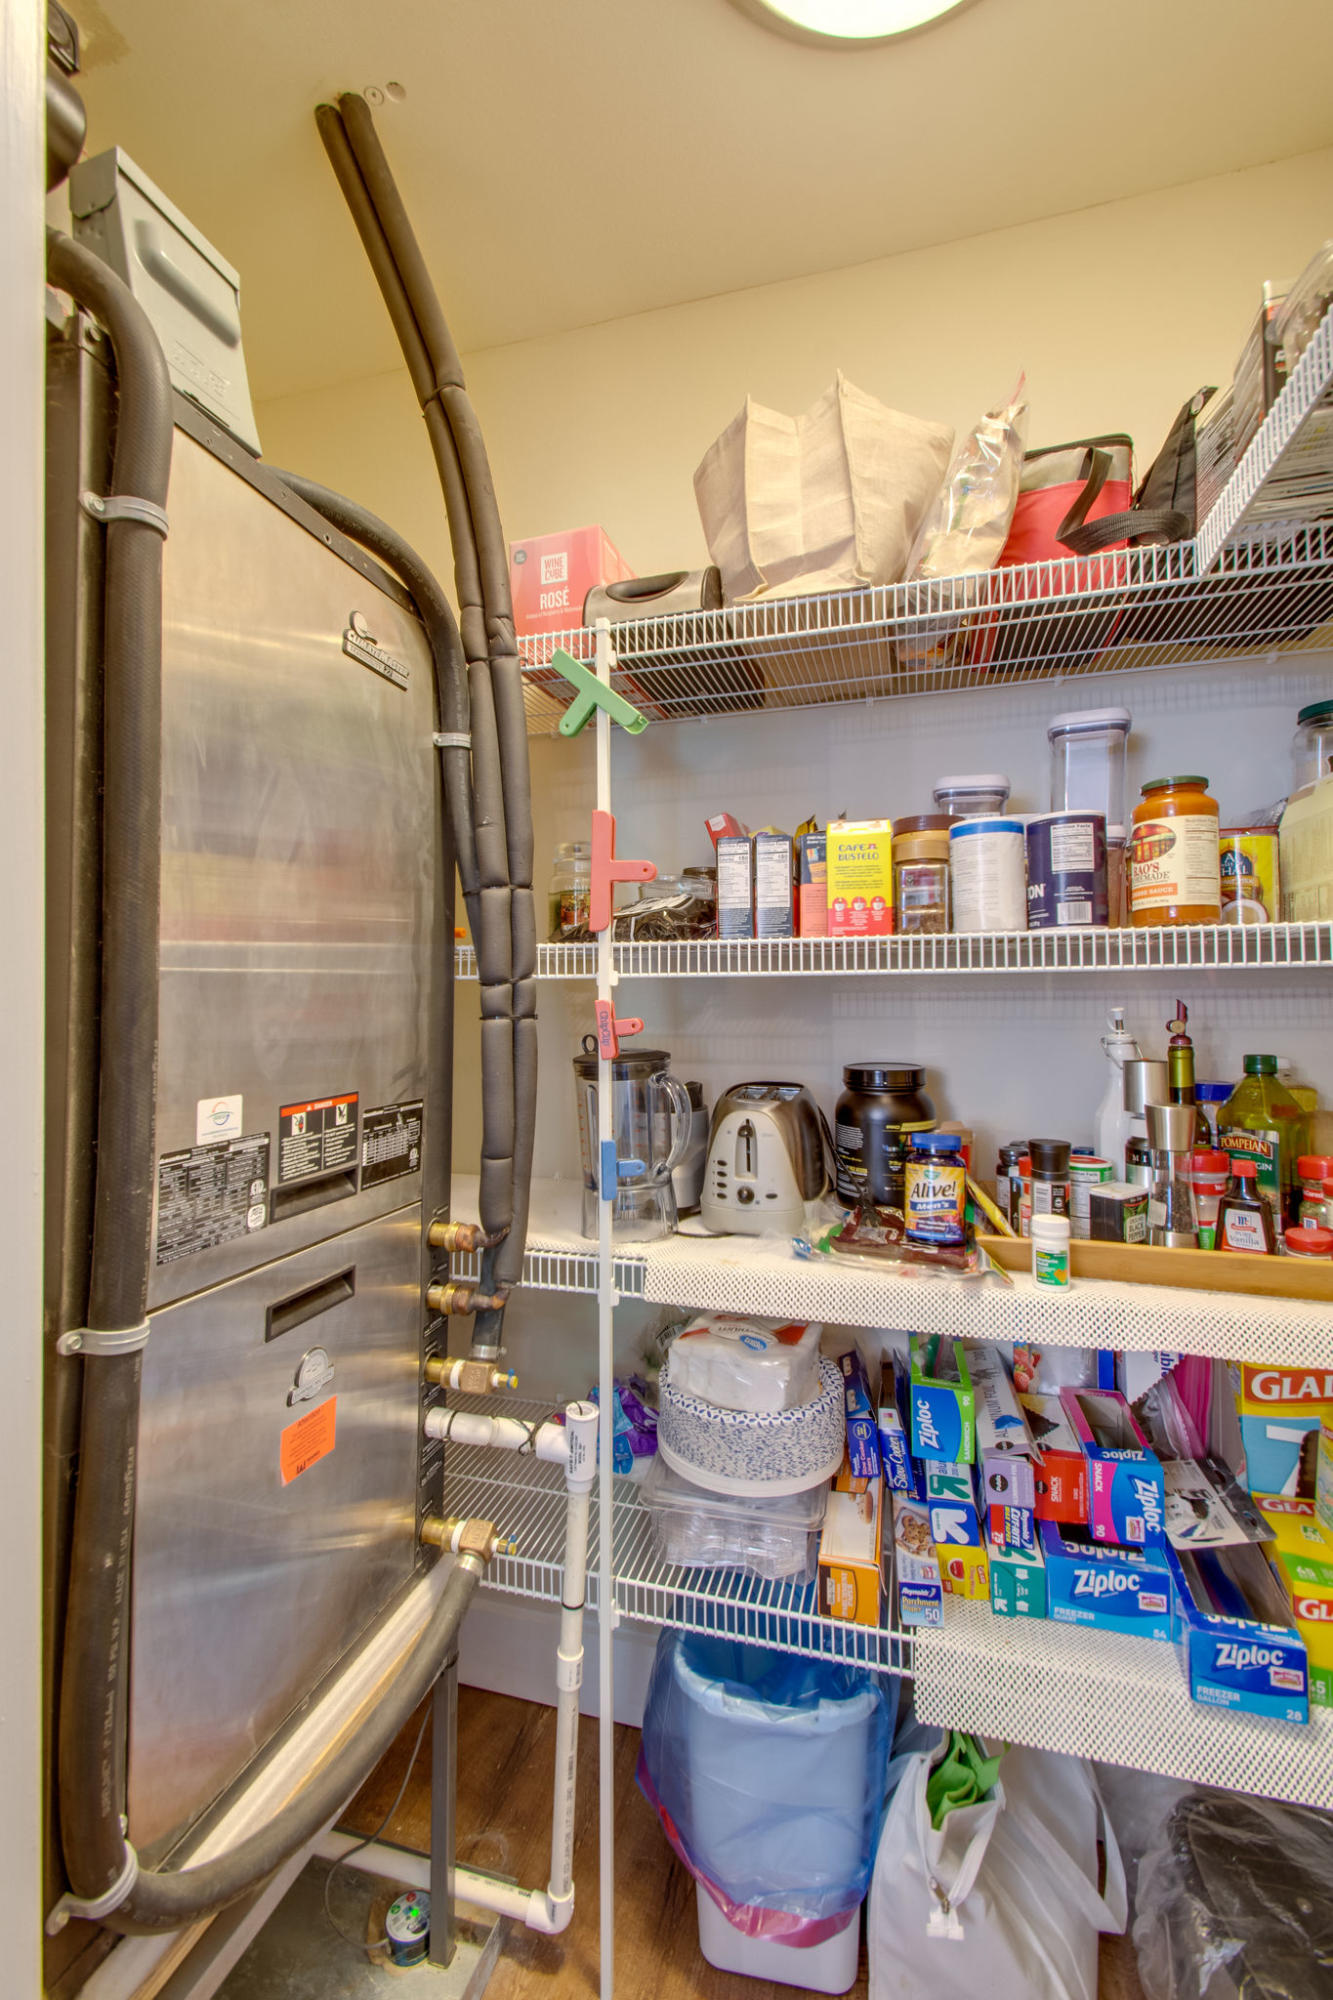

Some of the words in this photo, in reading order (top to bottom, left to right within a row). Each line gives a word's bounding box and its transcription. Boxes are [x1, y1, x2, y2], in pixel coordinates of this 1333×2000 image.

[544, 556, 564, 570] WINE
[544, 567, 564, 581] CUBE
[540, 585, 570, 610] ROSÉ
[838, 843, 865, 852] CAFE
[838, 852, 880, 861] BUSTELO
[1221, 1137, 1269, 1153] POMPEIAN
[1256, 1162, 1272, 1171] GIN
[911, 1181, 956, 1199] Alive!
[916, 1201, 950, 1211] Men's
[1230, 1234, 1260, 1246] Vanilla
[916, 1399, 940, 1449] Ziploc
[889, 1436, 904, 1464] Cooker
[1101, 1449, 1147, 1461] Ziploc
[894, 1464, 908, 1489] Slow
[1094, 1462, 1104, 1493] SNACK
[1050, 1475, 1058, 1502] SNACK
[1134, 1478, 1162, 1533] Ziploc
[1262, 1498, 1313, 1515] GLA
[1096, 1524, 1106, 1537] 90
[1074, 1569, 1141, 1598] Ziploc
[902, 1596, 939, 1607] Parchment
[925, 1607, 940, 1622] 50
[1054, 1606, 1095, 1620] FREEZER
[1215, 1643, 1284, 1670] Ziploc
[1196, 1685, 1241, 1702] FREEZER
[1286, 1709, 1303, 1721] 28
